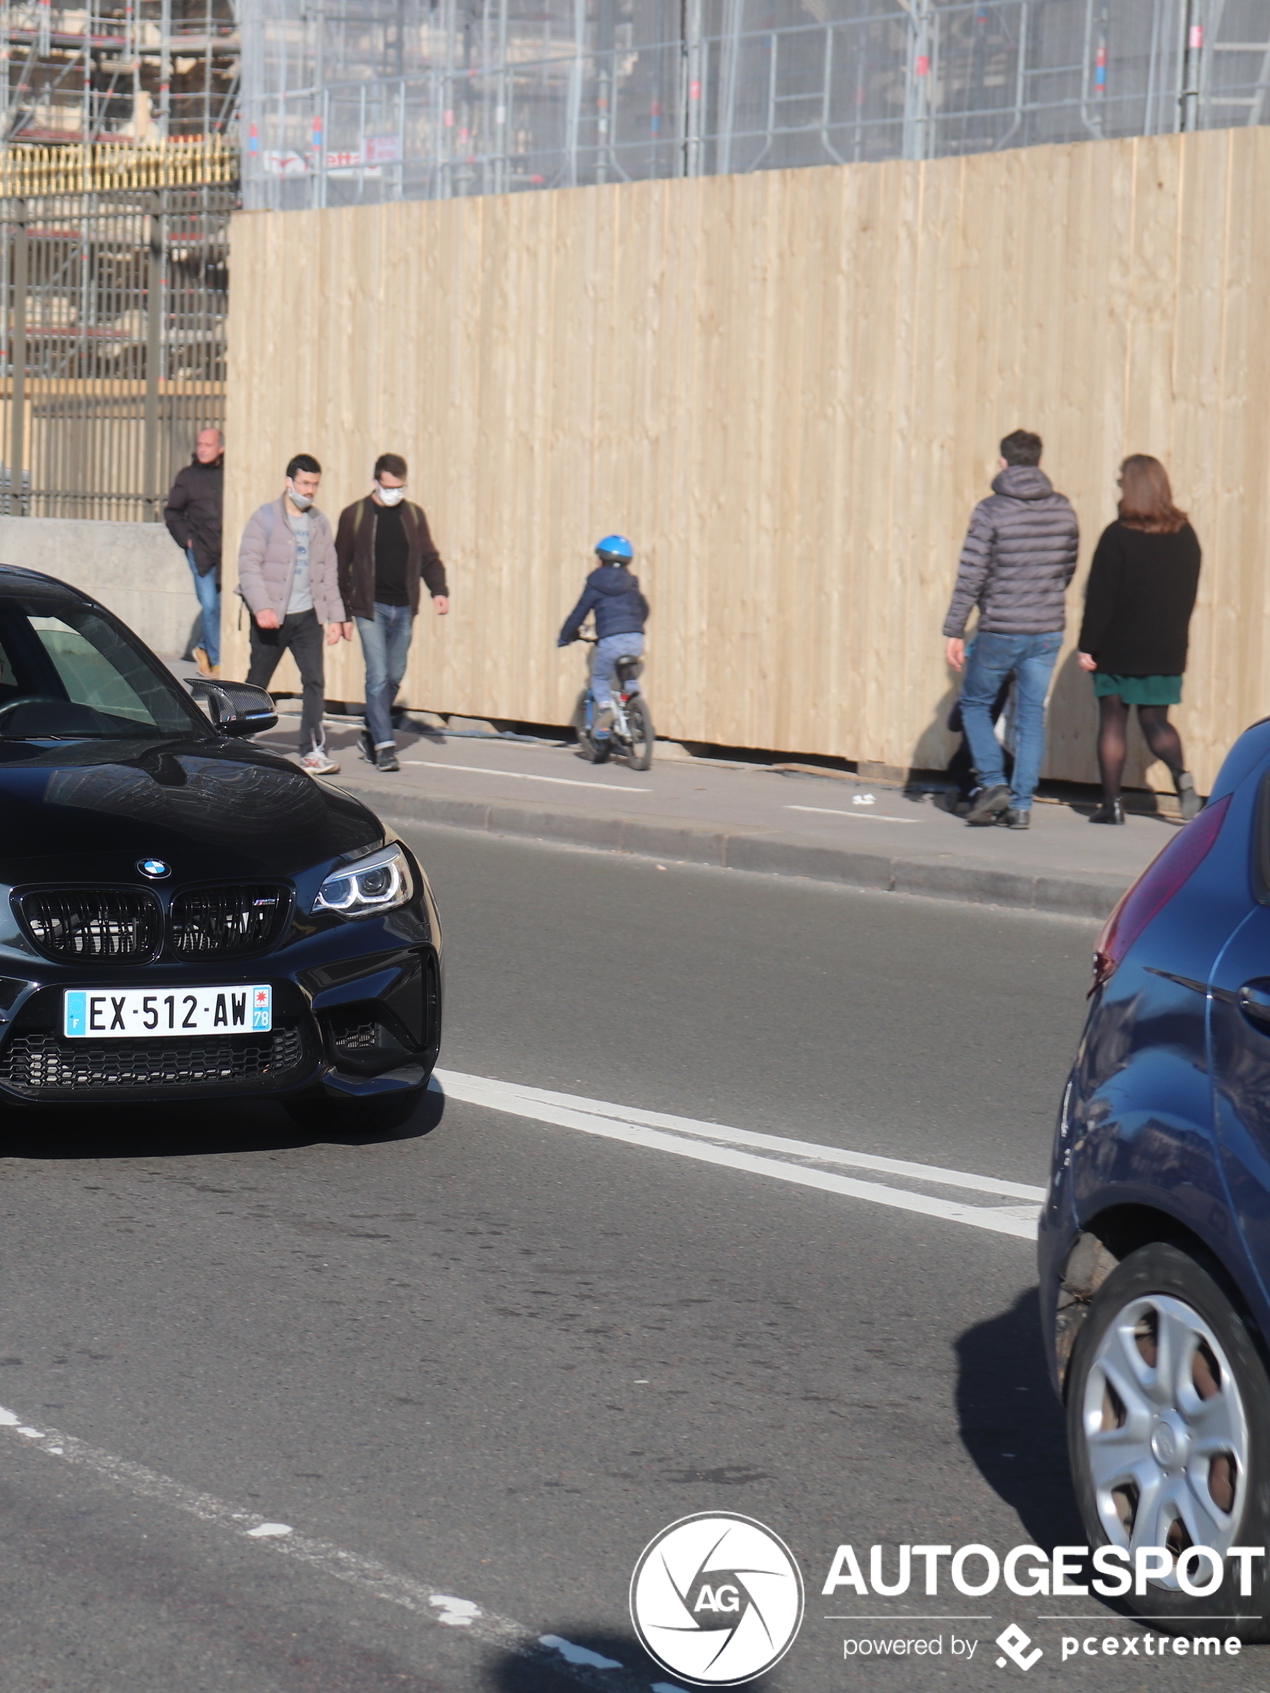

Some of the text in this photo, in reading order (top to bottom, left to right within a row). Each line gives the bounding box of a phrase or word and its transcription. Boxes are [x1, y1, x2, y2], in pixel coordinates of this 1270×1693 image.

[89, 992, 246, 1031] EX-512-AW
[254, 1010, 269, 1027] 78
[72, 1018, 80, 1029] F
